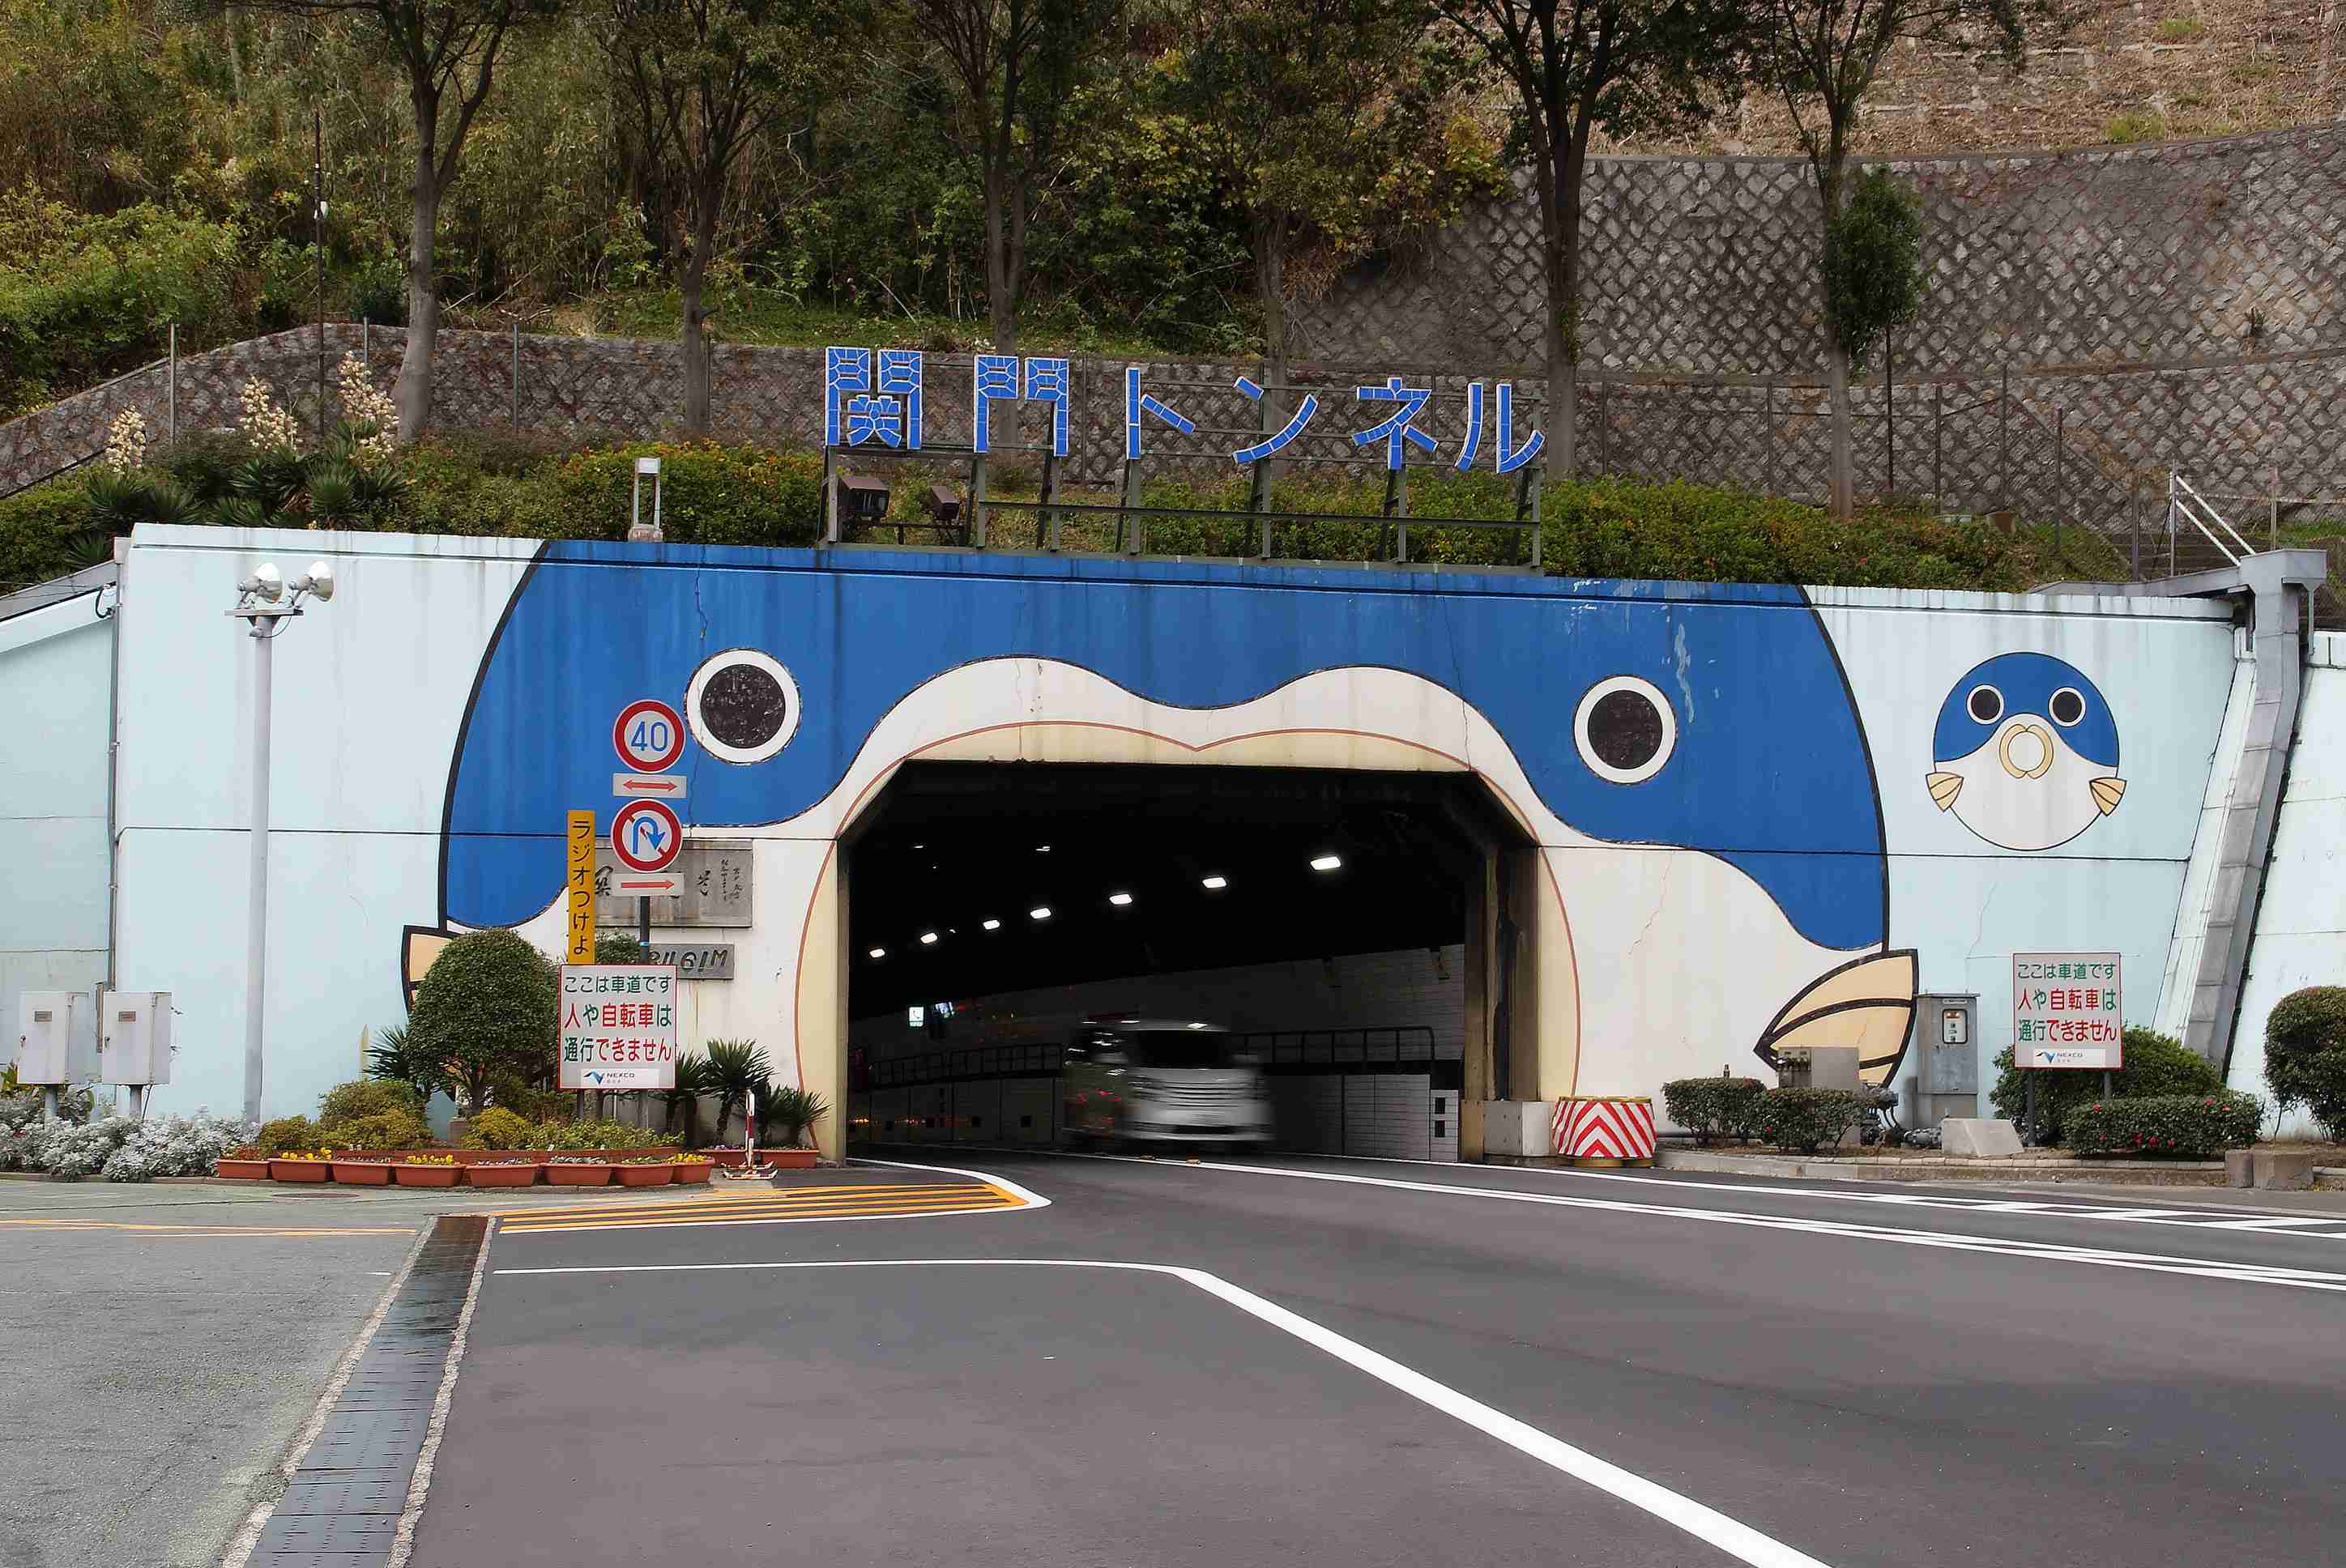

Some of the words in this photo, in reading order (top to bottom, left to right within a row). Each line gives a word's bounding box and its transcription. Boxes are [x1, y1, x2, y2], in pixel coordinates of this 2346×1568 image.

[825, 345, 1546, 475] 関門トンネル
[631, 721, 668, 752] 40
[573, 820, 591, 955] ラジオつけよ
[2018, 962, 2117, 979] ここは車道です
[565, 975, 672, 993] ここは車道です
[2018, 988, 2117, 1011] 人や自転車は
[565, 1003, 672, 1029] 人や自転車は
[2018, 1019, 2117, 1042] 通行できません
[564, 1037, 672, 1063] 通行できません
